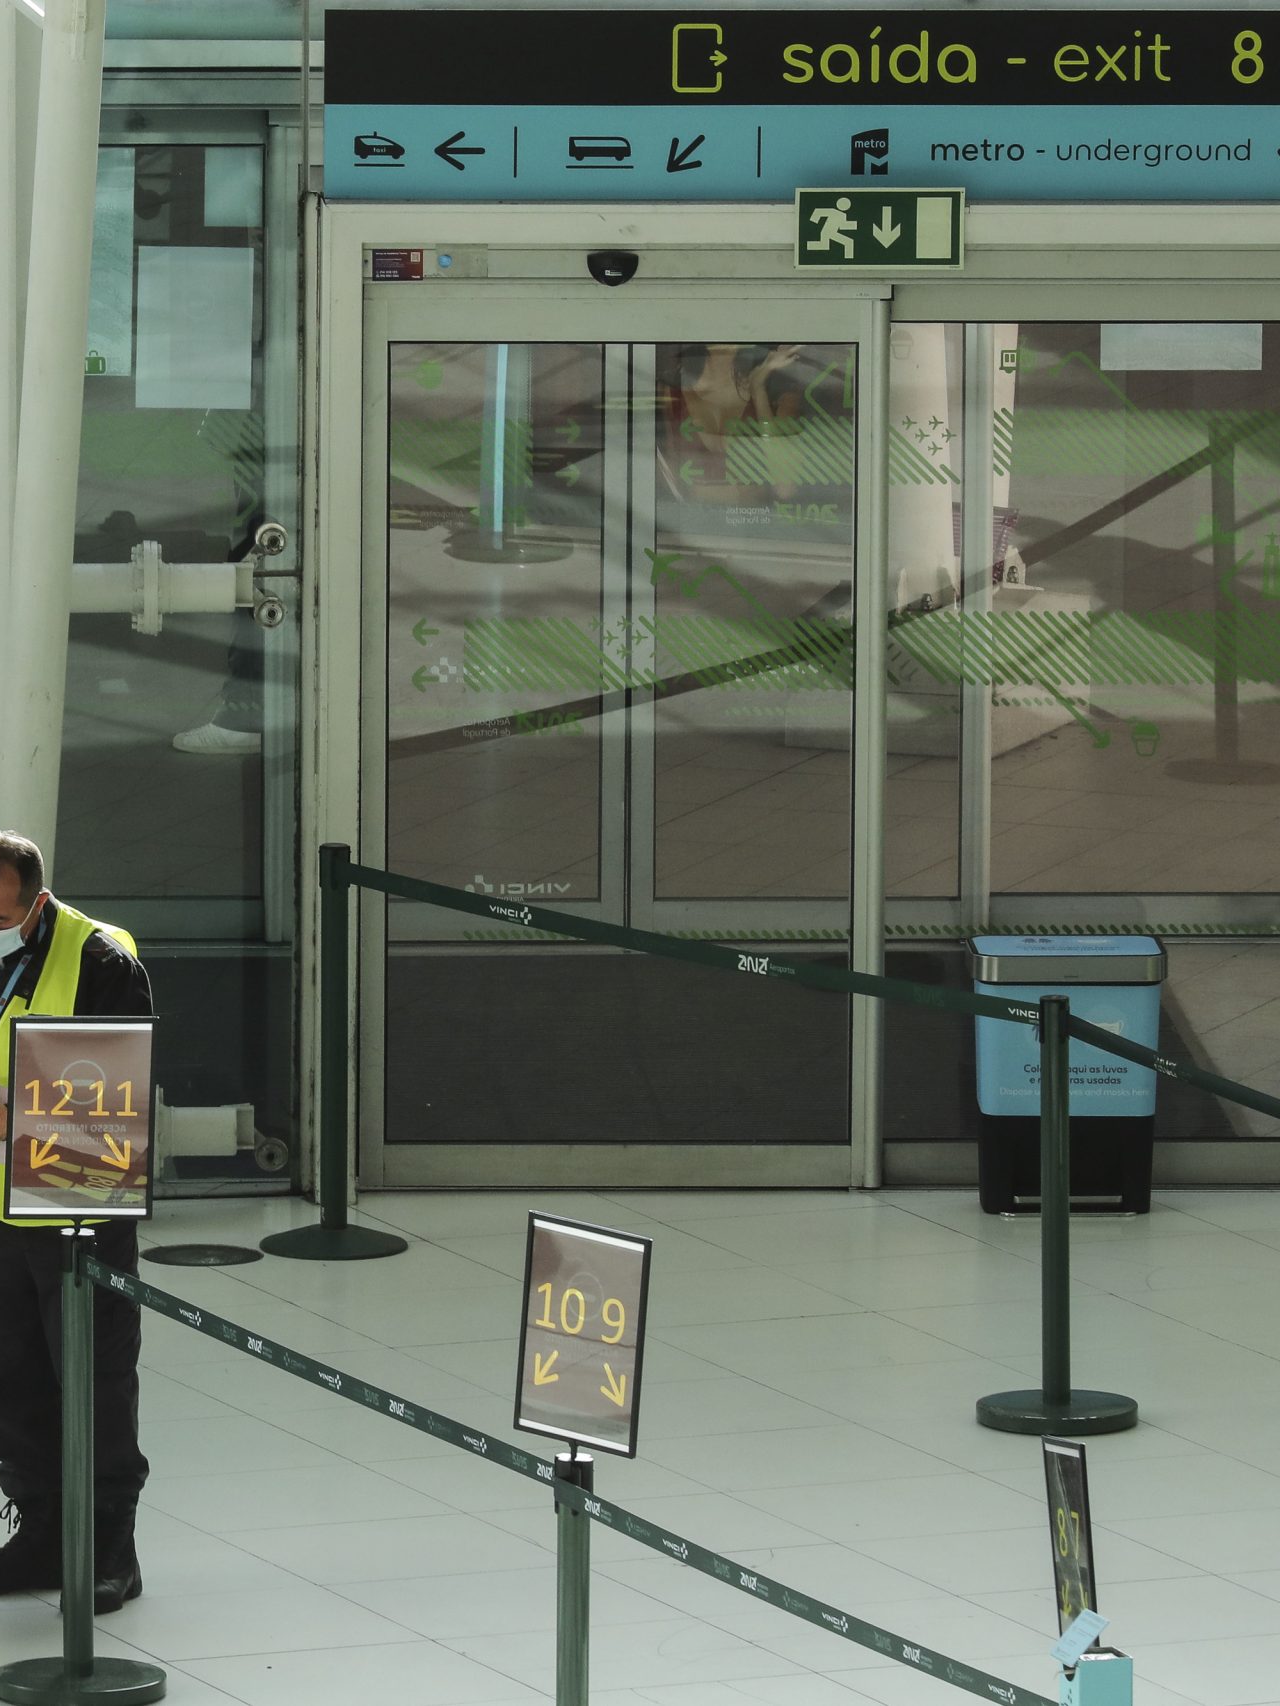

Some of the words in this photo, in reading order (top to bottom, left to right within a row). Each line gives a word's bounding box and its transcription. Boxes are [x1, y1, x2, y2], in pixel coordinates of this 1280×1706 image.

[782, 25, 977, 83] saída
[1053, 30, 1171, 82] exit
[1231, 30, 1264, 84] 8
[854, 139, 886, 149] metro
[931, 139, 1025, 162] metro
[1056, 138, 1251, 167] underground
[489, 904, 518, 918] VINCI
[1007, 1007, 1039, 1019] VINCI
[1103, 1064, 1128, 1074] luvas
[1087, 1075, 1121, 1085] usadas
[24, 1079, 74, 1116] 12
[88, 1080, 138, 1117] 11
[535, 1282, 586, 1335] 10
[601, 1298, 626, 1344] 9
[1057, 1507, 1068, 1557] 8
